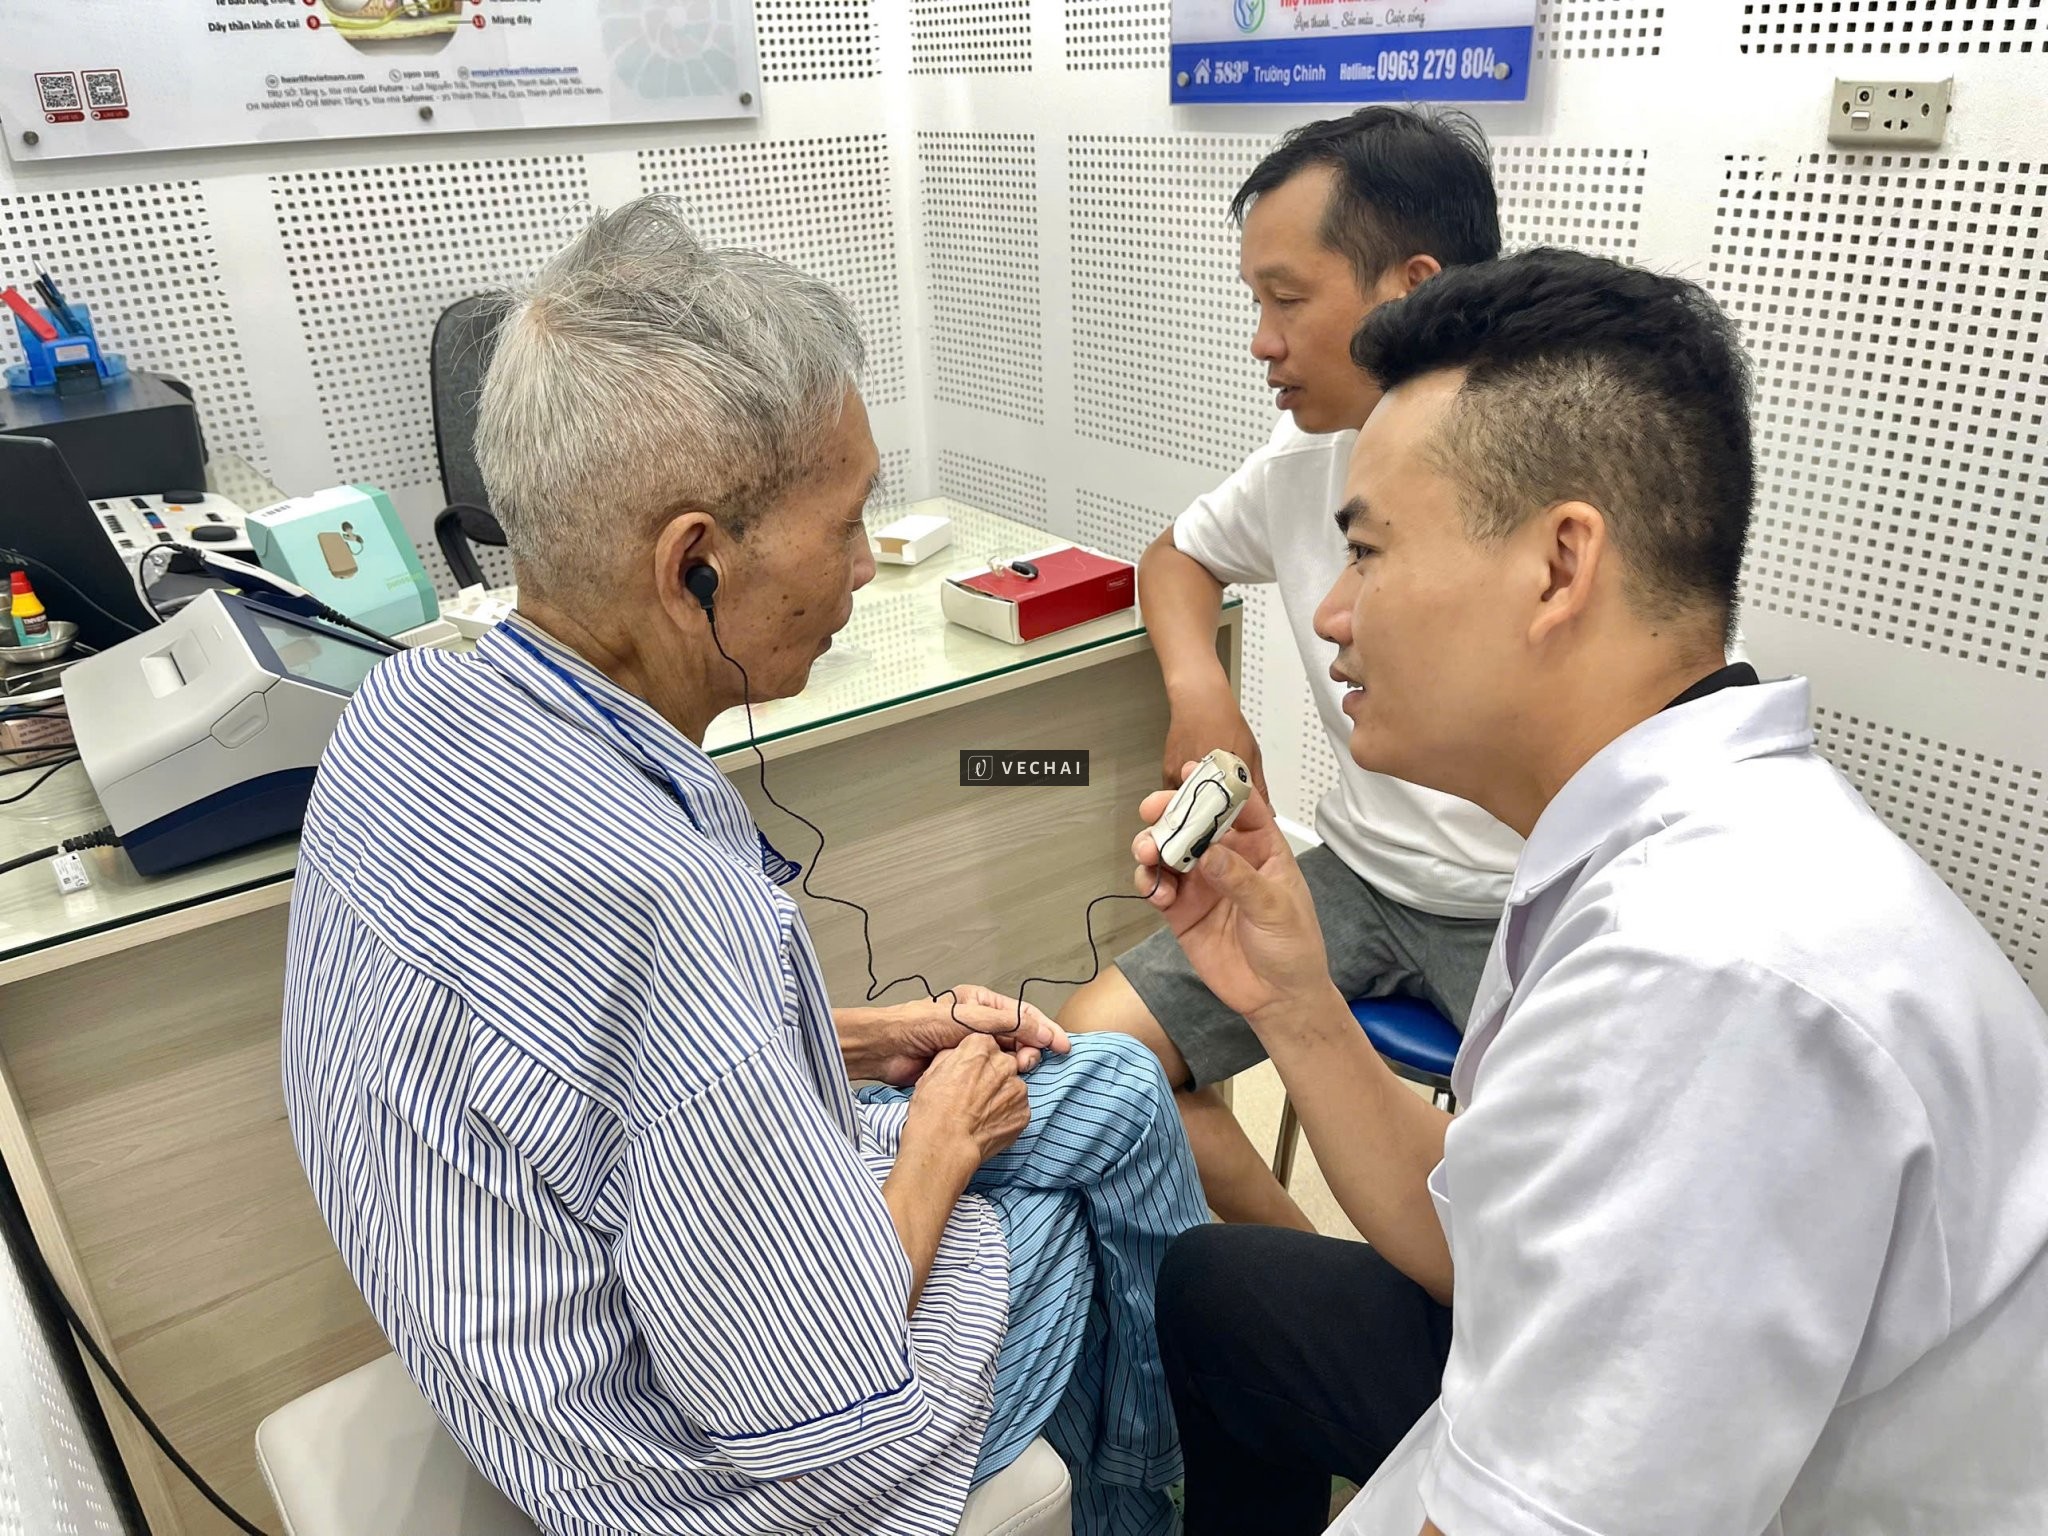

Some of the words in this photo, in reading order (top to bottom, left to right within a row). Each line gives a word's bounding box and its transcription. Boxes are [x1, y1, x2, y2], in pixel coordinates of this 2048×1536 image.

[208, 21, 227, 33] Dây
[228, 20, 251, 31] thần
[252, 19, 273, 30] kinh
[286, 19, 300, 28] tai
[1407, 7, 1426, 27] sống
[1339, 63, 1376, 81] Hotline:
[1377, 50, 1420, 82] 0963
[1422, 48, 1457, 80] 279
[1460, 47, 1495, 80] 804
[1253, 65, 1291, 87] Trường
[1293, 64, 1326, 82] Chinh
